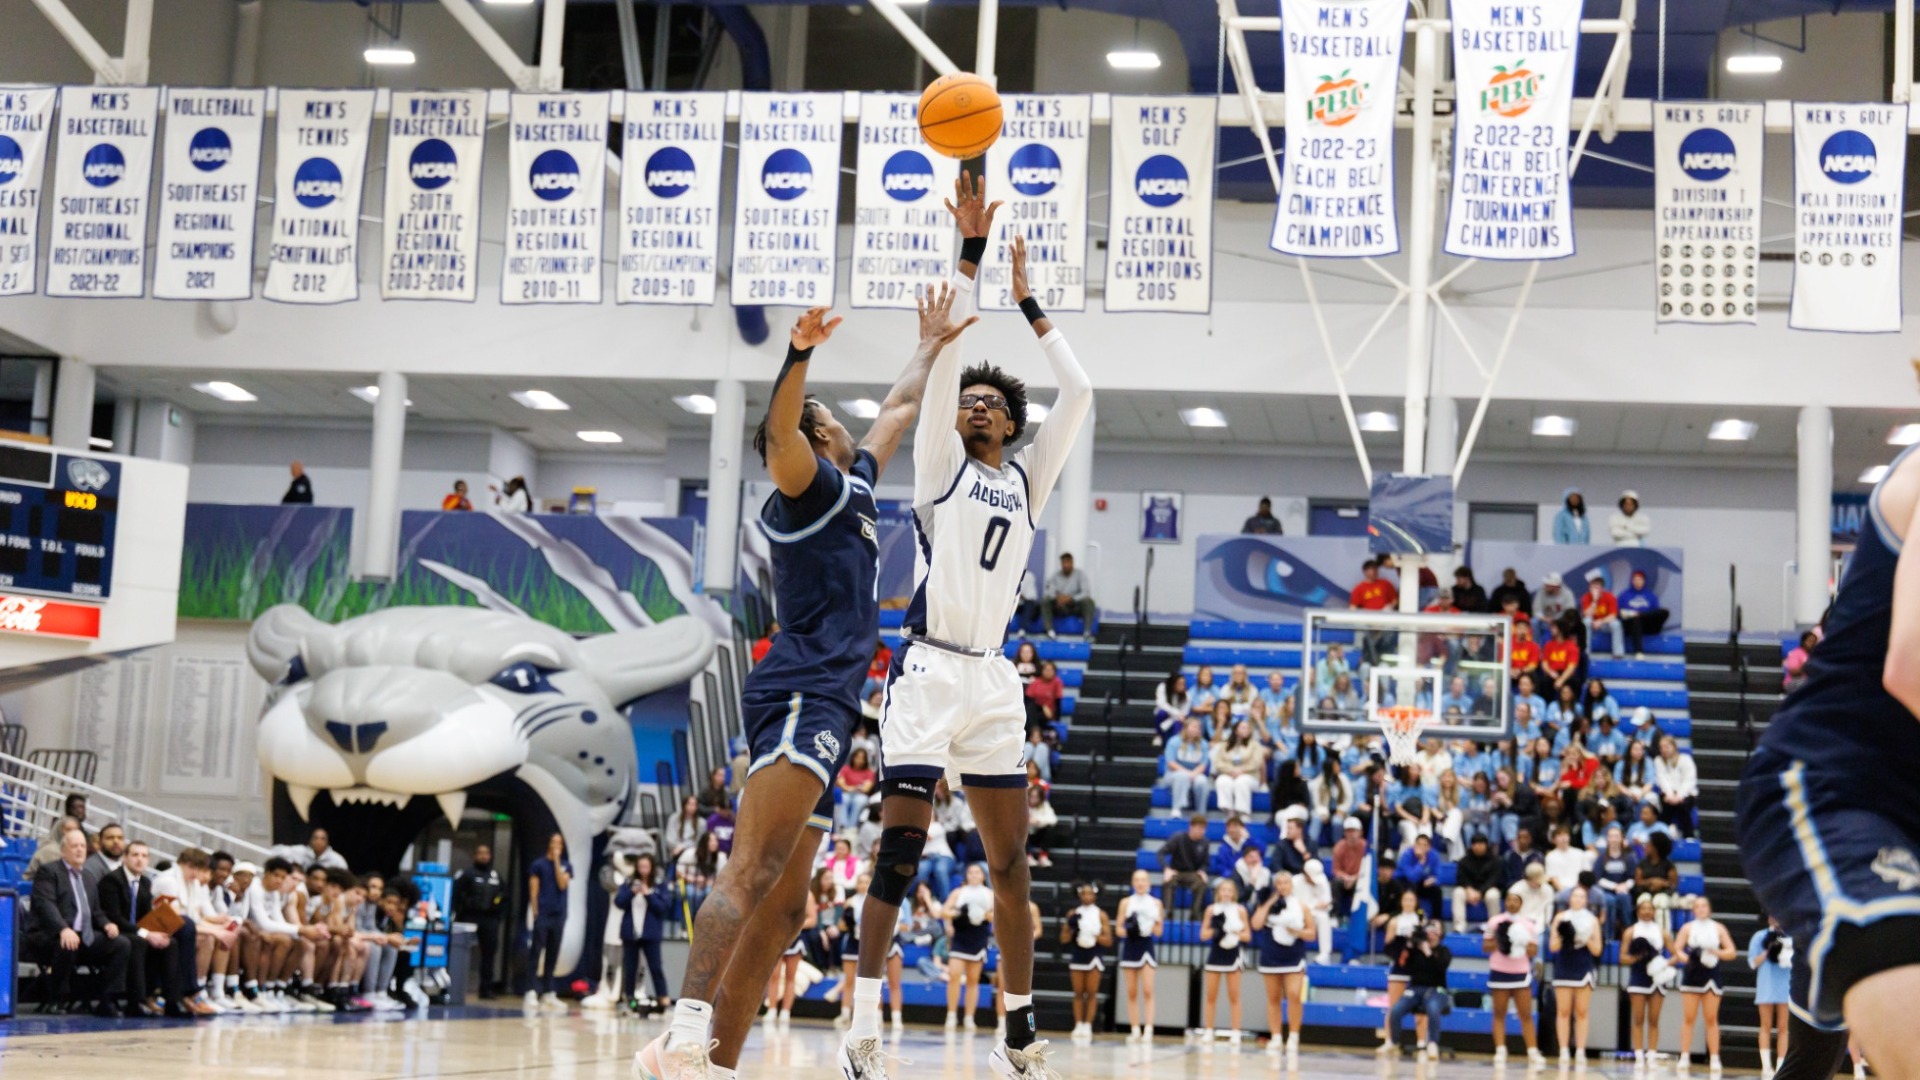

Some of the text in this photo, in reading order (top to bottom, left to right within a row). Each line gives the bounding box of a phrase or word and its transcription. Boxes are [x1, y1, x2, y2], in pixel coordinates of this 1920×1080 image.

[1318, 7, 1368, 28] MEN'S
[1491, 6, 1542, 26] MEN'S
[1290, 33, 1392, 57] BASKETBALL
[1462, 29, 1569, 52] BASKETBALL
[91, 93, 130, 110] MEN'S
[173, 98, 255, 116] VOLLEYBALL
[305, 101, 346, 119] MEN'S
[410, 98, 470, 116] WOMEN'S
[538, 101, 581, 118] MEN'S
[653, 100, 697, 118] MEN'S
[769, 100, 814, 118] MEN'S
[1015, 100, 1061, 118] MEN'S
[1140, 107, 1187, 125] MEN'S
[1665, 108, 1750, 124] MEN'S GOLF
[1807, 110, 1893, 125] MEN'S GOLF
[67, 118, 148, 136] BASKETBALL
[393, 119, 480, 137] BASKETBALL
[516, 124, 601, 142] BASKETBALL
[628, 122, 717, 141] BASKETBALL
[744, 123, 836, 142] BASKETBALL
[1001, 120, 1084, 139] ASKETBALL
[1474, 125, 1554, 146] 2022-23
[298, 128, 349, 146] TENNIS
[1143, 128, 1182, 146] GOLF
[84, 163, 124, 178] NCAA
[412, 163, 457, 178] NCAA
[1684, 153, 1736, 170] NCAA
[1824, 155, 1876, 172] NCAA
[532, 173, 580, 190] NCAA
[648, 171, 695, 187] NCAA
[764, 172, 812, 189] NCAA
[886, 173, 933, 190] NCAA
[1012, 167, 1061, 184] NCAA
[168, 184, 247, 202] SOUTHEAST
[1138, 178, 1189, 196] NCAA
[1462, 173, 1560, 197] CONFERENCE
[410, 193, 453, 211] SOUTH
[1673, 188, 1726, 203] DIVISION
[1801, 194, 1829, 207] NCAA
[1836, 194, 1885, 208] DIVISION
[60, 197, 139, 215] SOUTHEAST
[1012, 202, 1058, 220] SOUTH
[1288, 193, 1384, 217] CONFERENCE
[1465, 199, 1556, 222] TOURNAMENT
[174, 213, 234, 231] REGIONAL
[398, 214, 463, 232] ATLANTIC
[511, 208, 596, 226] SOUTHEAST
[627, 207, 712, 225] SOUTHEAST
[744, 208, 829, 227] SOUTHEAST
[857, 208, 890, 225] SOUTH
[1663, 208, 1753, 222] CHAMPIONSHIP
[1802, 213, 1893, 227] CHAMPIONSHIP
[65, 223, 131, 240] REGIONAL
[1125, 217, 1194, 236] CENTRAL
[1286, 223, 1384, 247] CHAMPIONS
[1663, 227, 1753, 241] APPEARANCES
[397, 233, 459, 251] REGIONAL
[516, 233, 588, 251] REGIONAL
[632, 230, 703, 249] REGIONAL
[749, 232, 820, 251] REGIONAL
[867, 232, 939, 253] REGIONAL
[1460, 224, 1560, 248] CHAMPIONS
[1803, 232, 1892, 247] APPEARANCES
[54, 248, 140, 266] HOST/CHAMPIONS
[171, 242, 234, 260] CHAMPIONS
[998, 245, 1067, 263] RIONAL
[1122, 239, 1196, 259] REGIONAL
[390, 253, 466, 272] CHAMPIONS
[622, 254, 712, 274] HOST/CHAMPIONS
[738, 255, 830, 276] HOST/CHAMPIONS
[858, 257, 947, 277] HOST/CHAMPIONS
[1116, 261, 1202, 280] CHAMPIONS
[69, 273, 120, 291] 2021-22
[186, 272, 215, 289] 2021
[293, 274, 326, 292] 2012
[388, 273, 464, 291] 2003-2004
[1055, 267, 1081, 285] SEED
[523, 280, 580, 299] 2010-11
[750, 280, 816, 299] 2008-09
[1137, 283, 1176, 301] 2005
[980, 516, 1011, 572] 0
